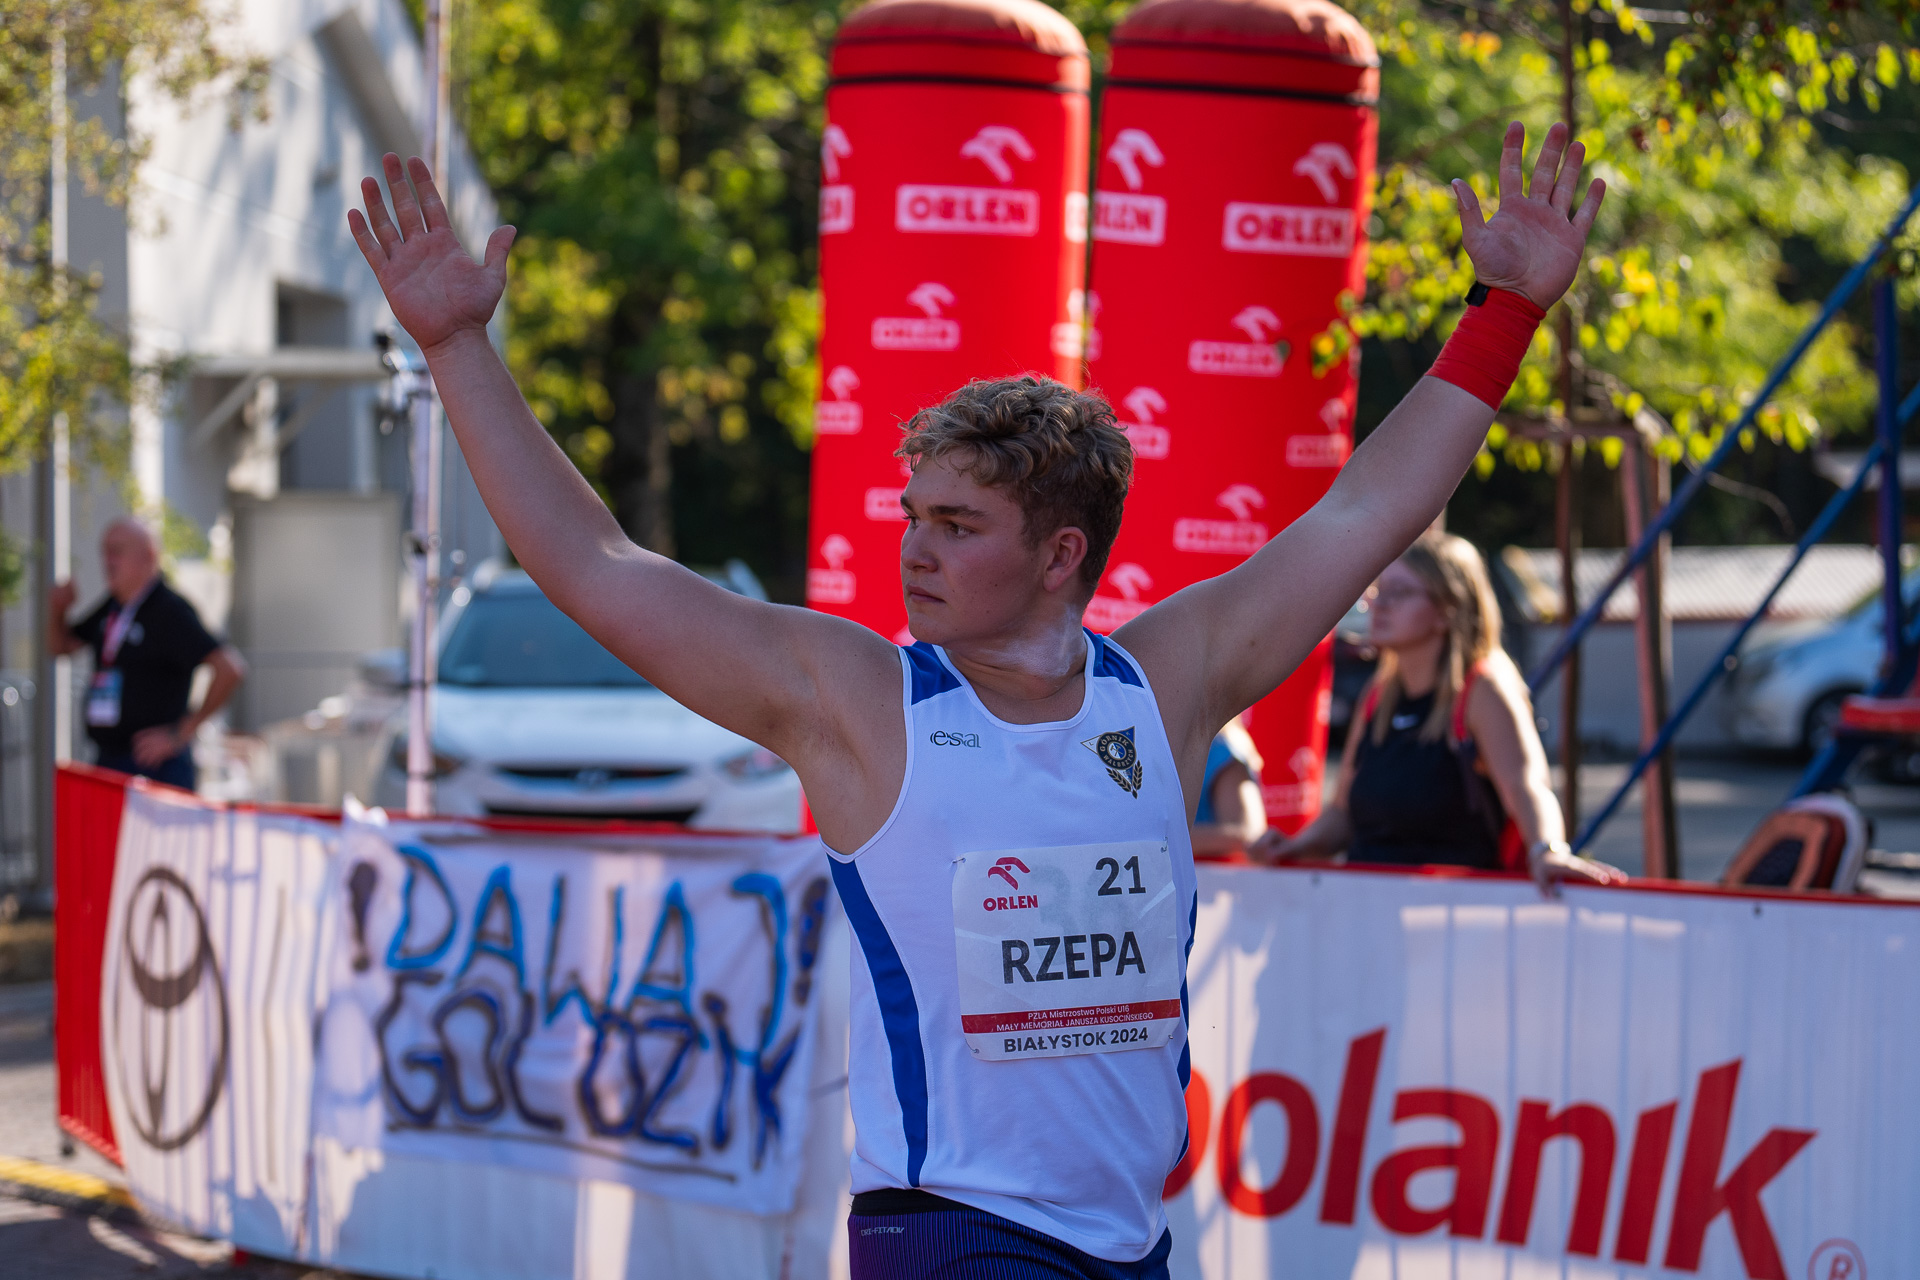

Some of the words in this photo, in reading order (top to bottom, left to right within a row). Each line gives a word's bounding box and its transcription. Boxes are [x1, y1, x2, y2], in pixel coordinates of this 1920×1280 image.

[1095, 855, 1147, 897] 21
[983, 894, 1039, 912] ORLEN
[1001, 931, 1147, 985] RZEPA
[996, 1022, 1020, 1032] MAŁY
[1020, 1020, 1064, 1030] MEMORIAŁ
[1065, 1018, 1100, 1027] JANUSZA
[1100, 1012, 1154, 1024] KUSOCIŃSKIEGO
[1028, 1012, 1048, 1020] PZLA
[1050, 1009, 1095, 1019] Mistrzostwa
[1096, 1005, 1116, 1015] Polski
[1117, 1005, 1130, 1013] U16
[1004, 1031, 1107, 1053] BIAŁYSTOK
[1110, 1027, 1149, 1045] 2024
